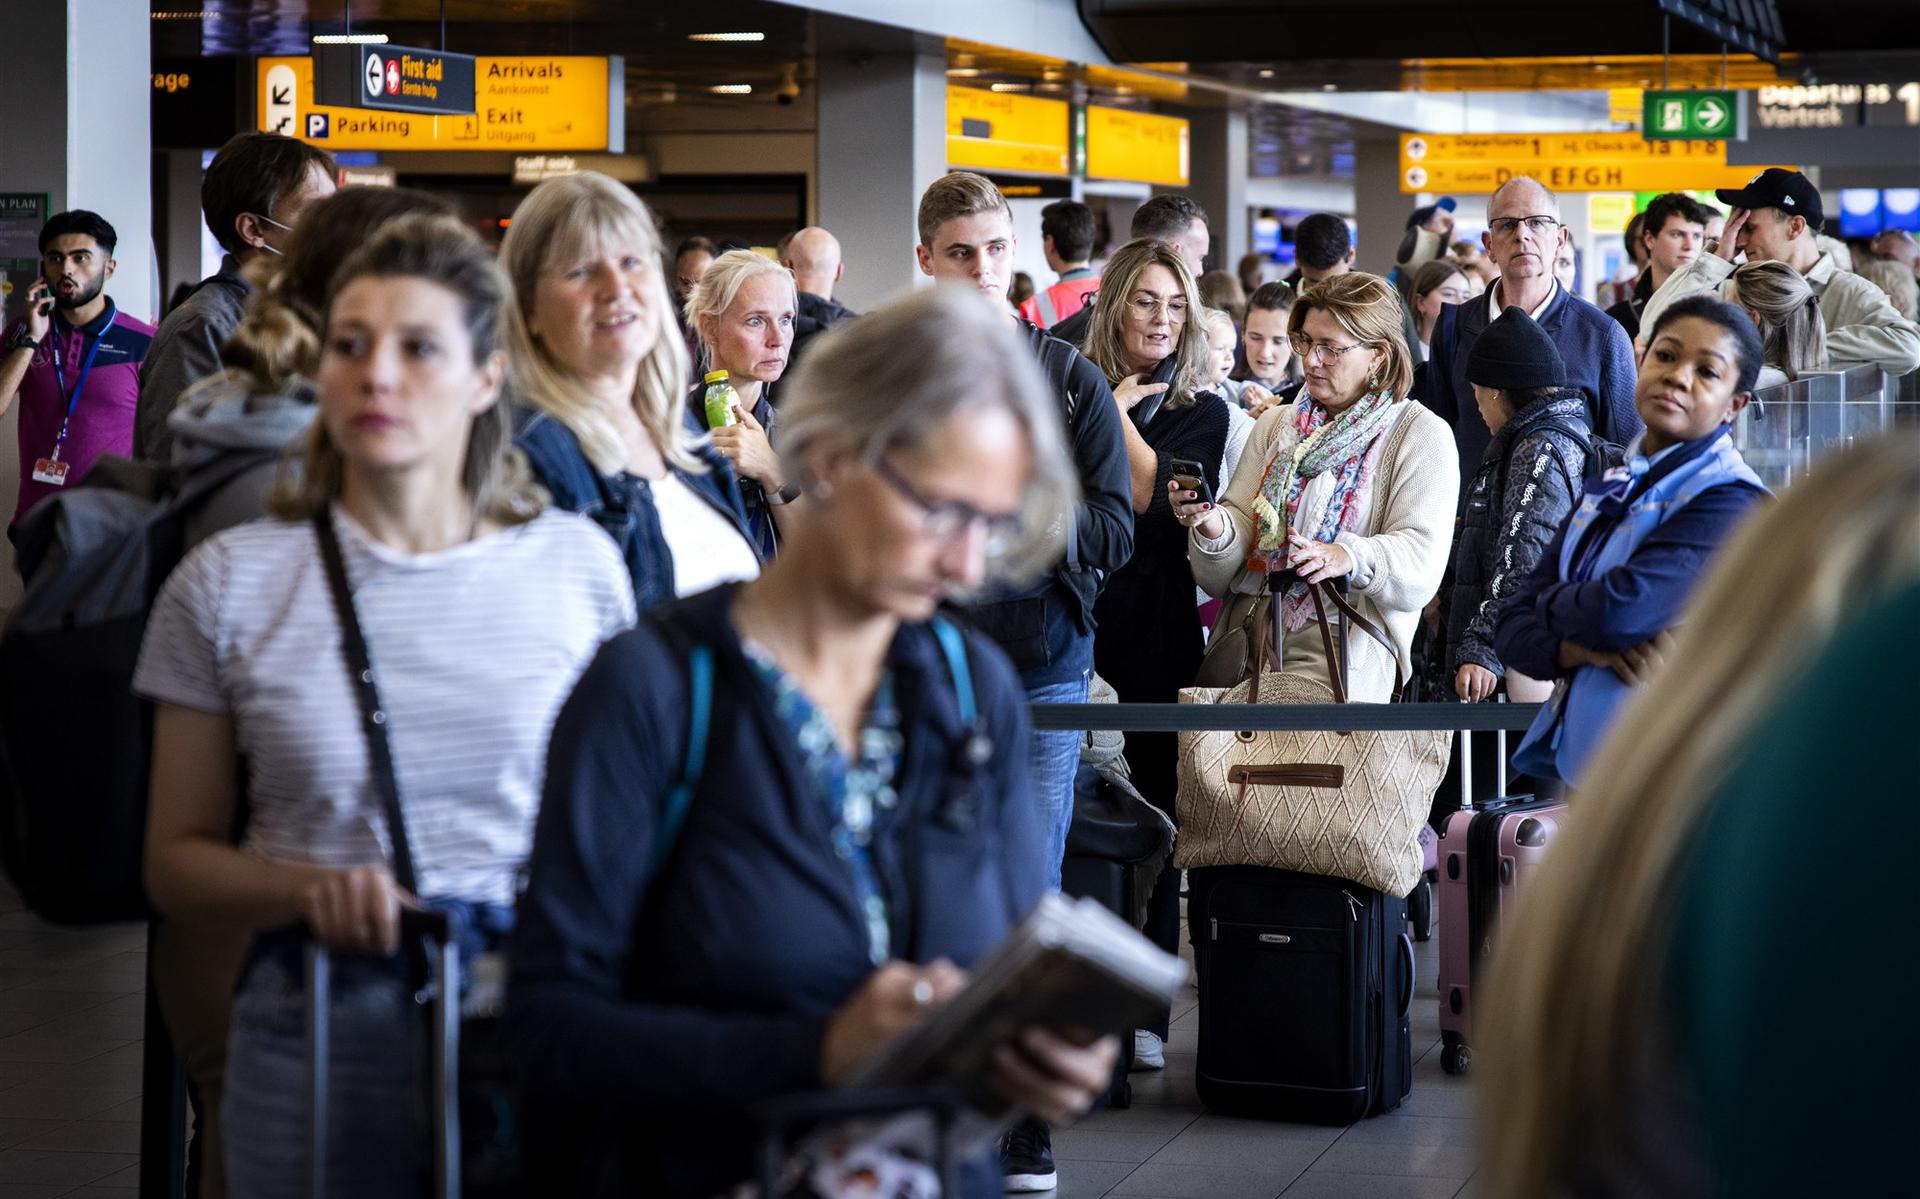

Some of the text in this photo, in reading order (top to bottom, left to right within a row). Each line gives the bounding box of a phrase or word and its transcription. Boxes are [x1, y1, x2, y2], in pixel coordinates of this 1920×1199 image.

[402, 55, 443, 81] First aid
[487, 61, 563, 78] Arrivals
[150, 73, 190, 93] age
[402, 79, 437, 100] Eerste hulp
[488, 82, 550, 95] Aankomst
[486, 107, 523, 124] Exit
[338, 116, 410, 136] Parking
[486, 129, 536, 143] Uitgang
[1532, 138, 1540, 156] 1
[9, 198, 36, 209] PLAN
